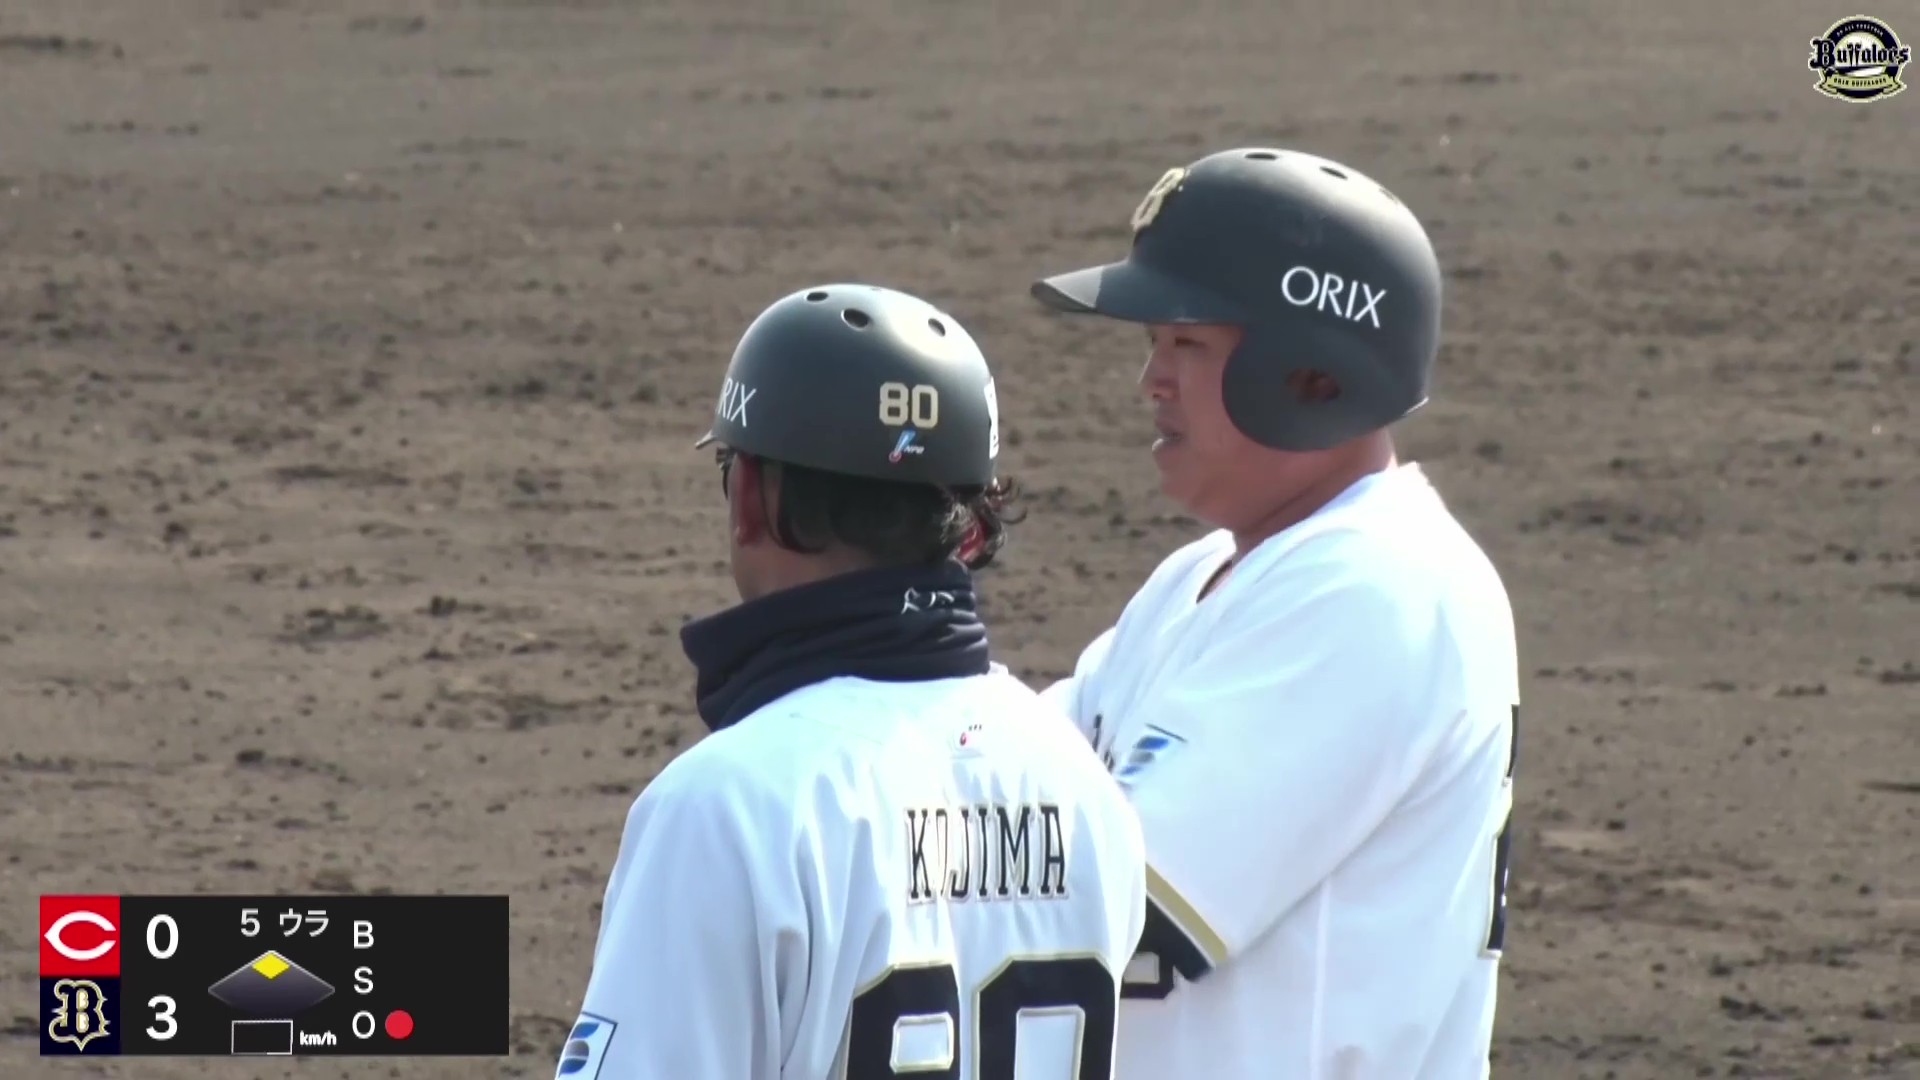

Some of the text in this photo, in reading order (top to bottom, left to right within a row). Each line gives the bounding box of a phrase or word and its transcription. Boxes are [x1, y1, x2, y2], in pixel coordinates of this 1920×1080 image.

[1281, 266, 1386, 329] ORIX
[716, 377, 757, 428] RIX
[879, 381, 938, 429] 80
[905, 803, 1067, 903] KOJIMA
